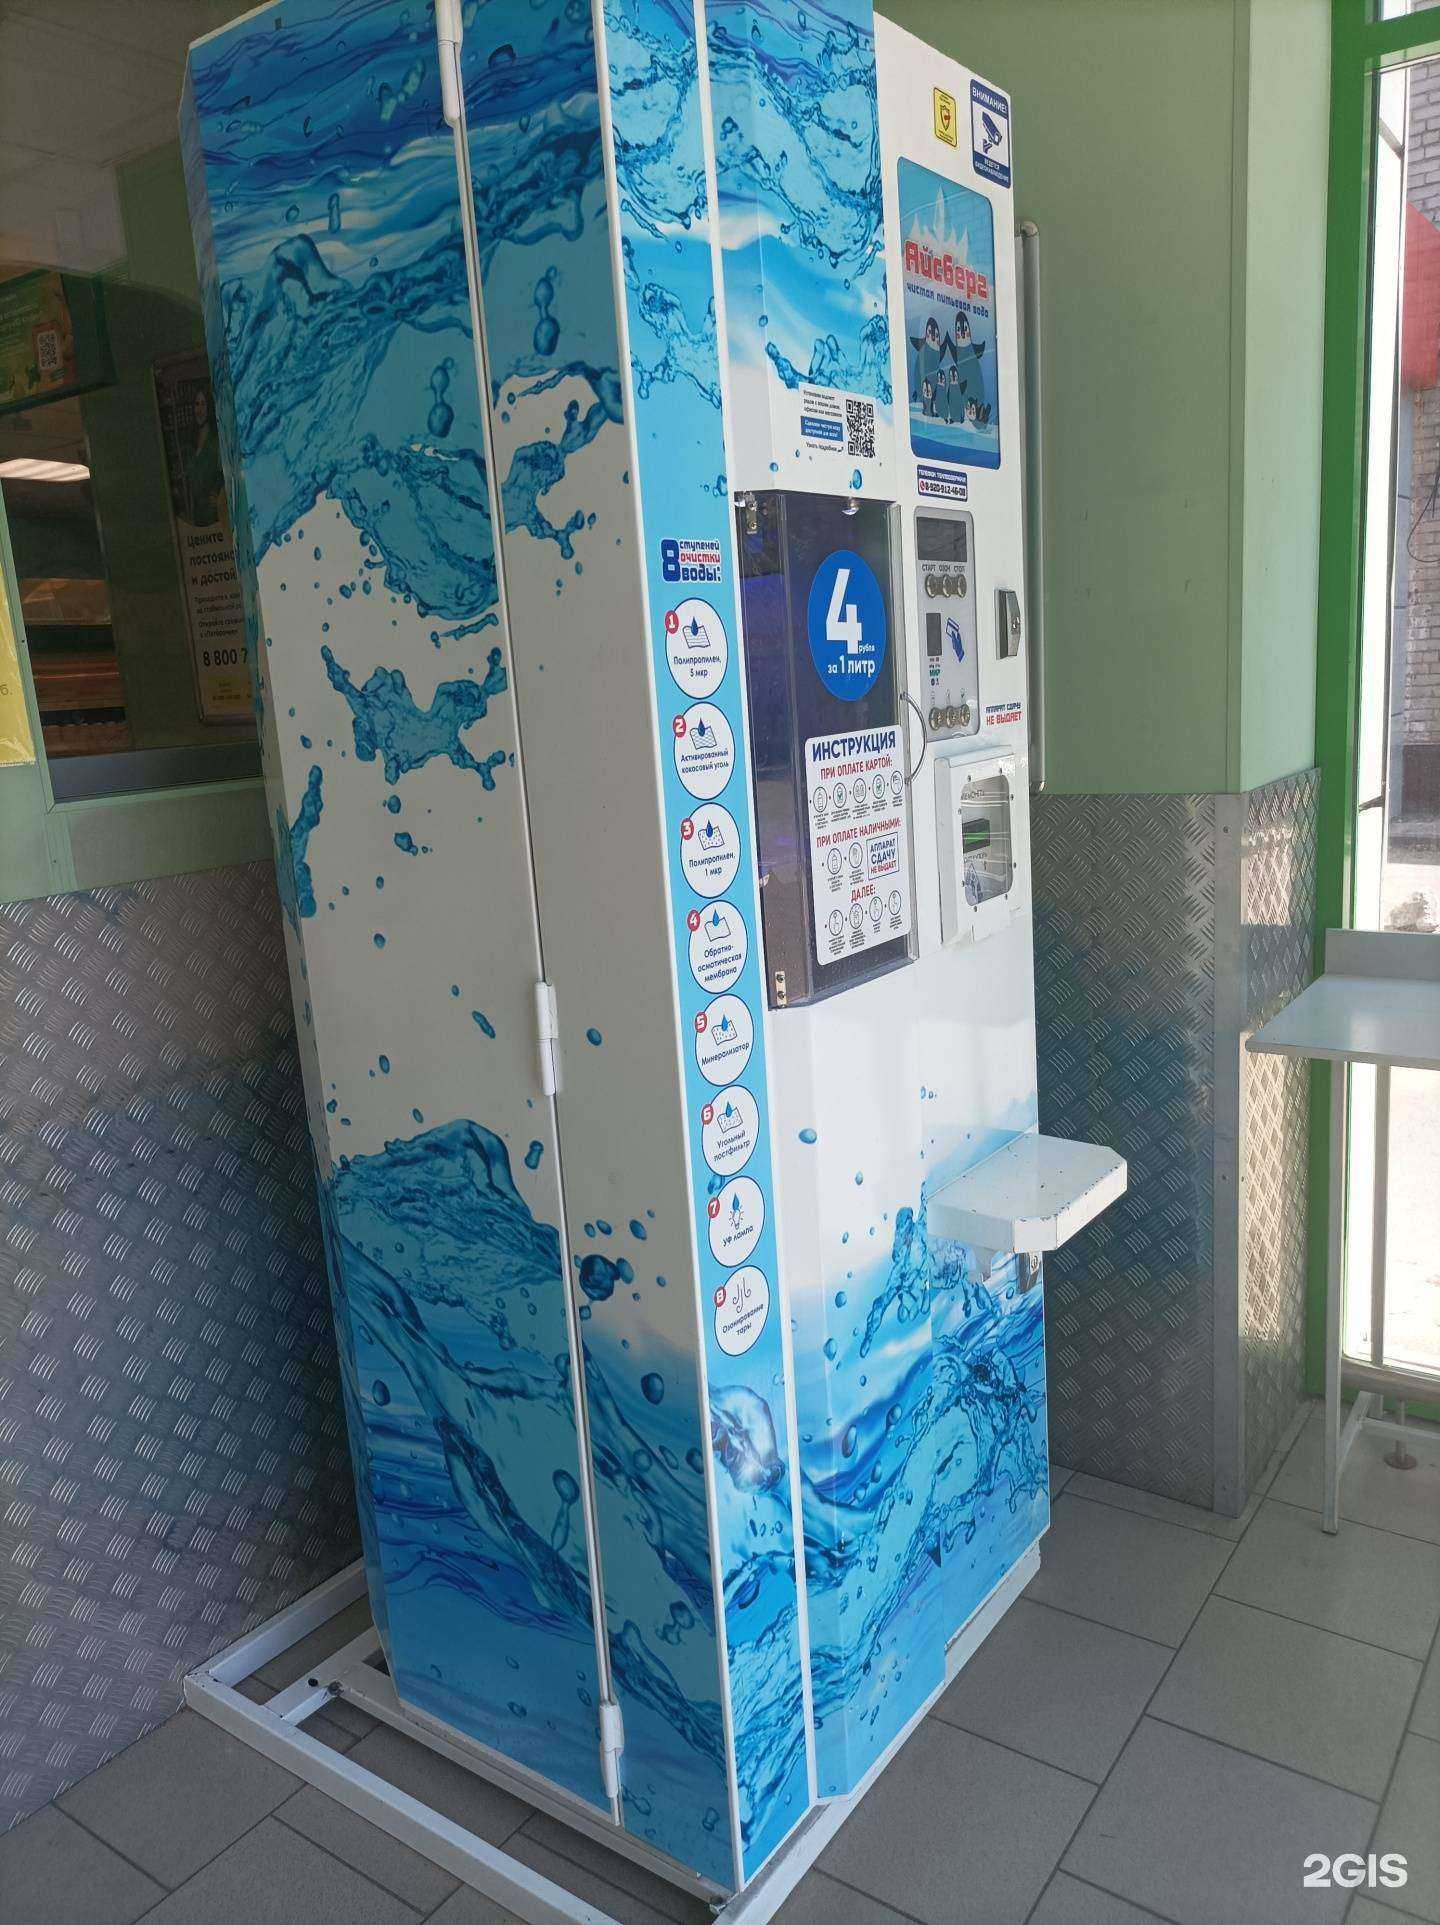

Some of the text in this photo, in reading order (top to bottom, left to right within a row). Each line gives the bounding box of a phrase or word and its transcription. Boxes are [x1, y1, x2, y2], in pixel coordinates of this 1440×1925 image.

[904, 240, 988, 300] Айсберг
[906, 282, 935, 301] чистая
[973, 302, 989, 318] вода
[187, 532, 224, 549] Цените
[660, 538, 720, 582] 8 ступеней
[680, 552, 721, 563] очистки
[192, 575, 199, 586] и
[681, 564, 721, 582] воды:
[826, 568, 862, 655] 4
[668, 614, 676, 629] 1
[203, 651, 211, 666] 8
[214, 649, 237, 665] 800
[673, 654, 722, 666] Полипропилен,
[690, 668, 708, 678] 5 мкр
[828, 655, 876, 678] за 1 литр
[675, 716, 684, 734] 2
[986, 710, 1022, 726] НЕ ВЫДАЕТ
[680, 747, 729, 763] Активированный
[812, 731, 896, 762] ИНСТРУКЦИЯ
[681, 760, 729, 774] кокосовый уголь
[820, 754, 893, 780] ПРИ ОПЛАТЕ КАРТОЙ:
[683, 820, 692, 837] 3
[816, 817, 902, 848] ПРИ ОПЛАТЕ НАЛИЧНЫМИ:
[870, 838, 896, 853] АППАРАТ
[688, 853, 736, 868] Полипропилен,
[871, 848, 896, 865] СДАЧУ
[710, 866, 723, 877] мкр
[870, 859, 897, 874] НЕ ВЫДАЕТ
[851, 883, 876, 903] ДАЛЕЕ:
[689, 914, 698, 927] 4
[704, 945, 734, 958] Обратно-
[697, 953, 742, 973] осмотическая
[704, 967, 738, 983] мембрана
[696, 1014, 706, 1030] 5
[701, 1042, 750, 1066] Минерализатор
[717, 1129, 746, 1149] Угольный
[714, 1139, 750, 1162] постфильтр
[710, 1199, 718, 1215] 7
[722, 1225, 754, 1247] УФ лампа
[716, 1289, 725, 1304] 8
[722, 1303, 764, 1334] Озонирование
[736, 1322, 752, 1336] тары
